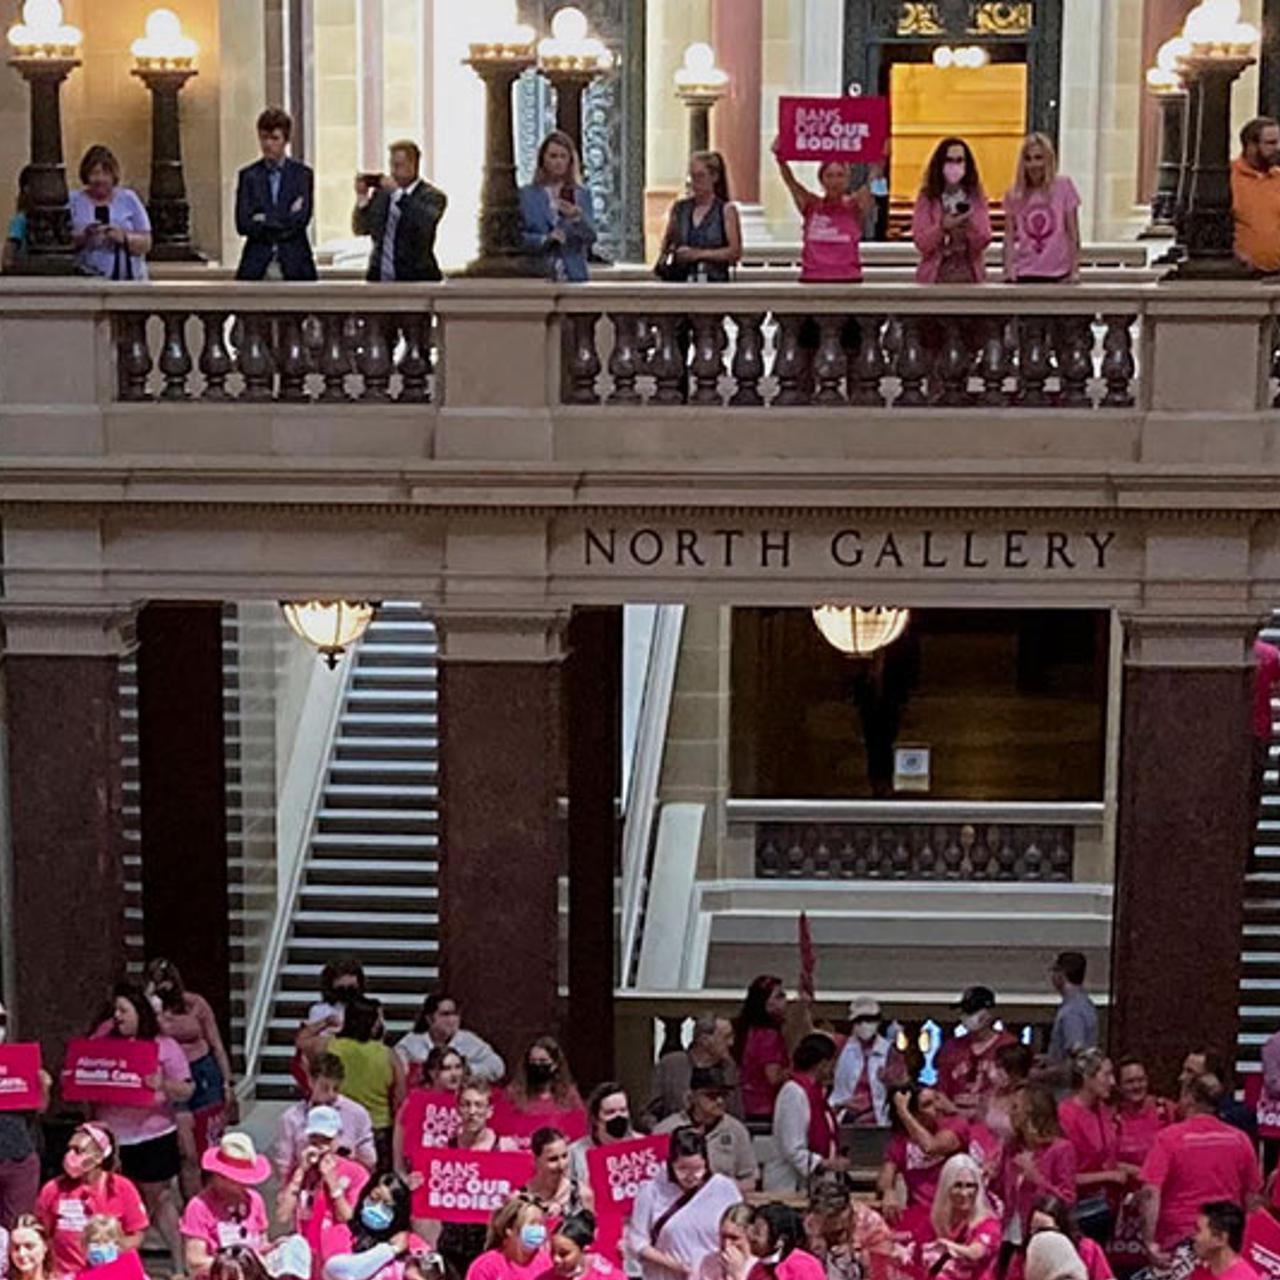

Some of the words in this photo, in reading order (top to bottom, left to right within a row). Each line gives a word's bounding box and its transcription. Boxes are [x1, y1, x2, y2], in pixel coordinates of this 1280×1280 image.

[795, 108, 842, 124] BANS
[795, 122, 831, 138] OFF
[831, 122, 869, 138] OUR
[795, 136, 862, 152] BODIES
[583, 529, 791, 567] NORTH
[829, 529, 1117, 568] GALLERY
[607, 1147, 657, 1172] BANS
[429, 1160, 481, 1179] BANS
[609, 1165, 646, 1186] OFF
[429, 1177, 467, 1192] OFF
[466, 1179, 511, 1195] OUR
[429, 1192, 504, 1209] BODIES
